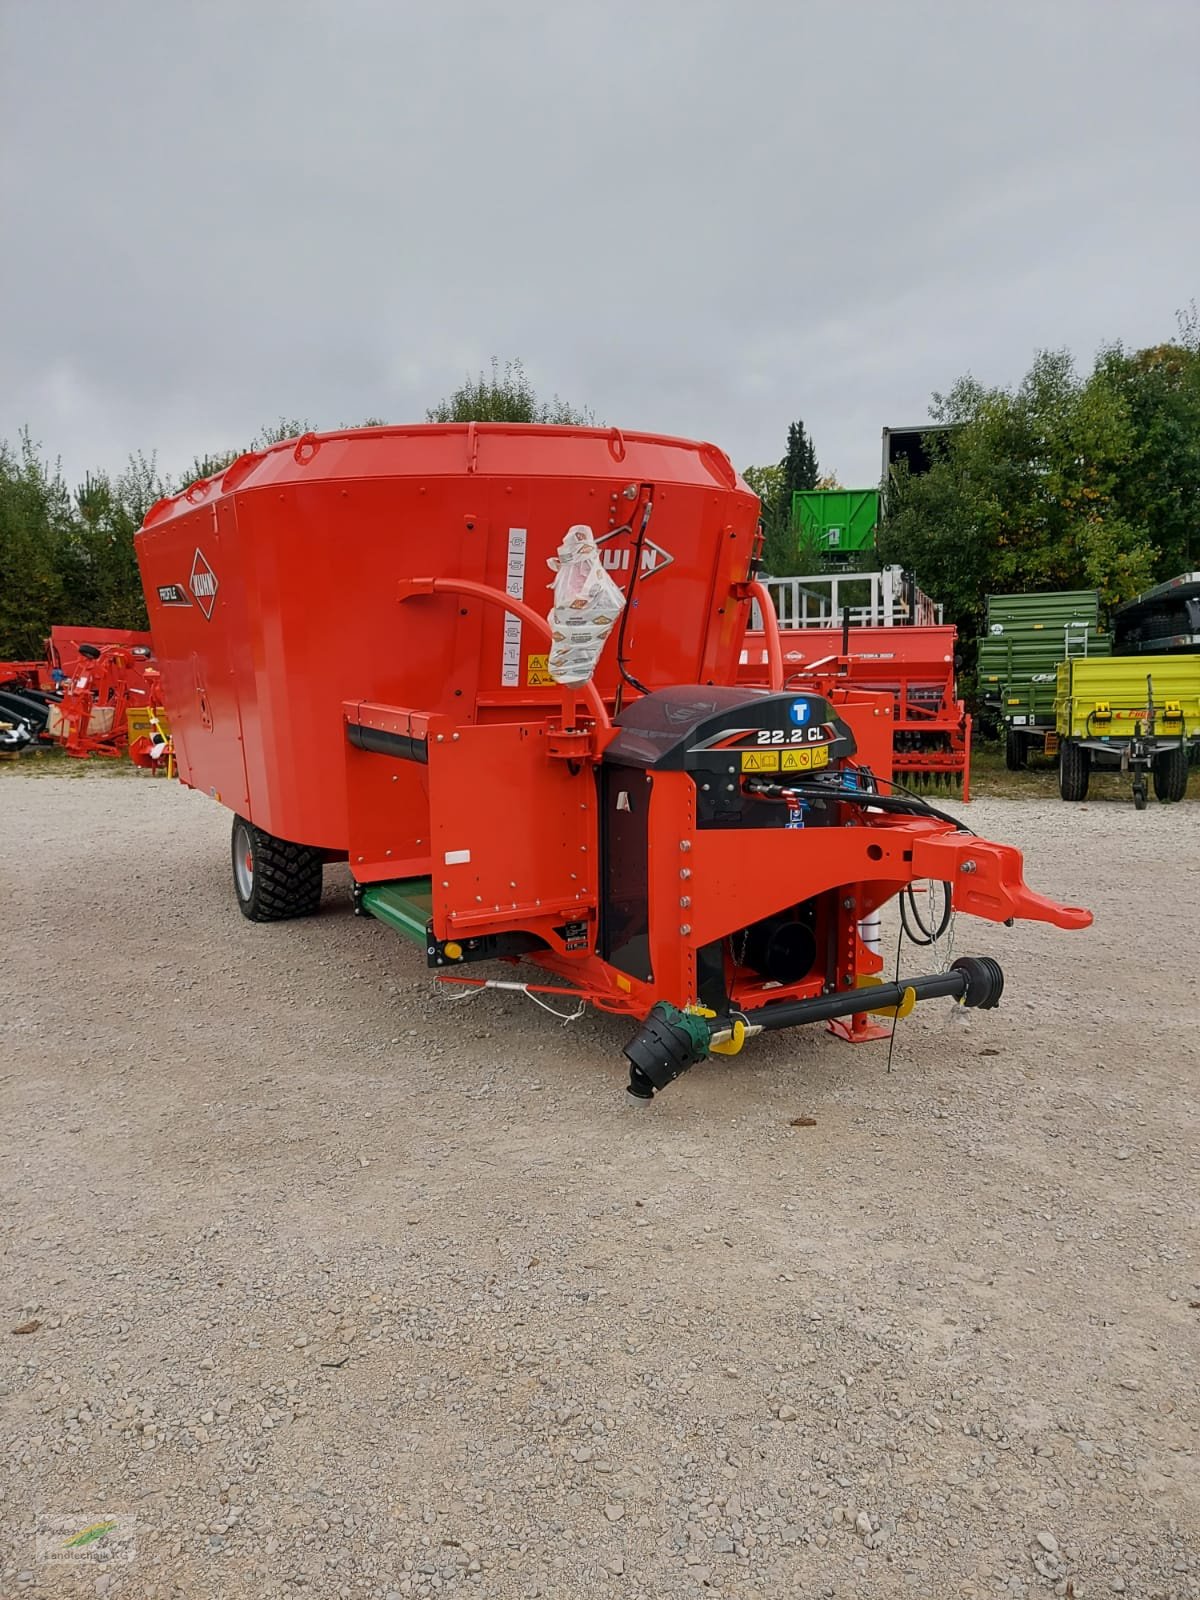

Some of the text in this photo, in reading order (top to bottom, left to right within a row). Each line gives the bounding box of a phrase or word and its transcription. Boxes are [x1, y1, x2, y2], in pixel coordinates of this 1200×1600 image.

[793, 703, 808, 721] T
[757, 727, 824, 745] 22.2 CL
